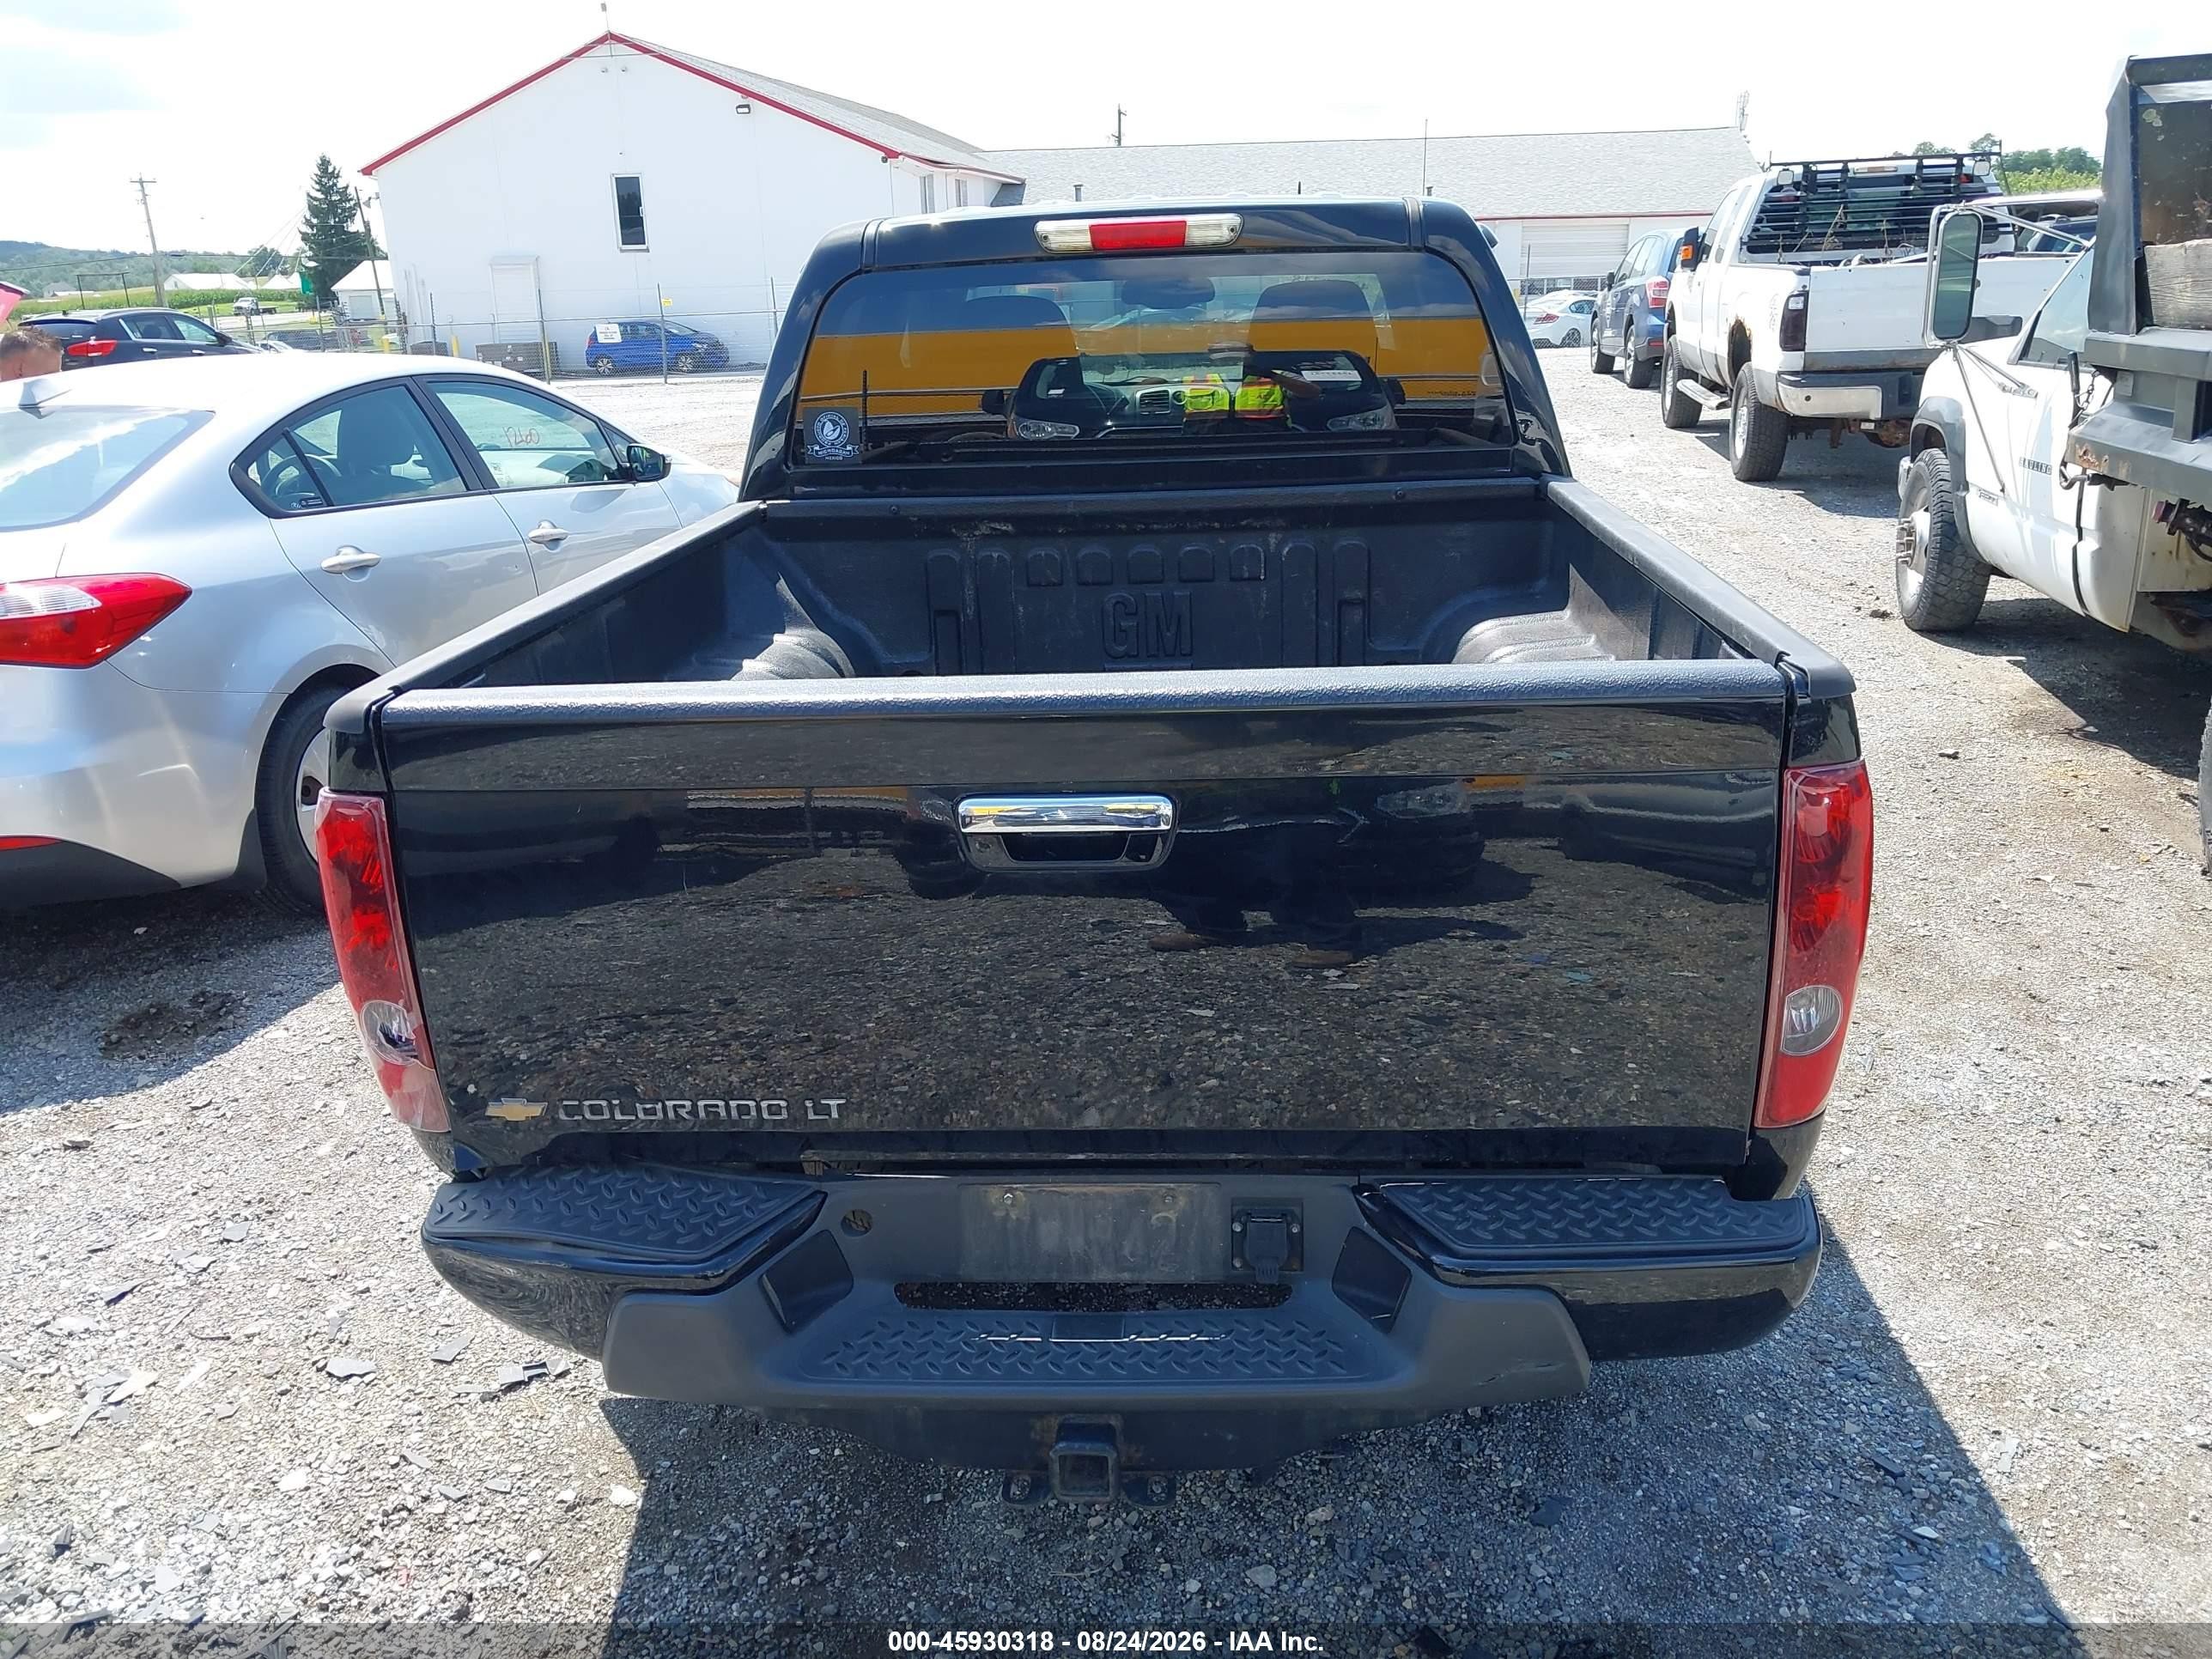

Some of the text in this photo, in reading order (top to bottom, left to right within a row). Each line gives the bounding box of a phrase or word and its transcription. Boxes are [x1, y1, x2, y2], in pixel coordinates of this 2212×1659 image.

[1101, 592, 1193, 659] GM
[558, 1098, 847, 1121] COLORADO LT
